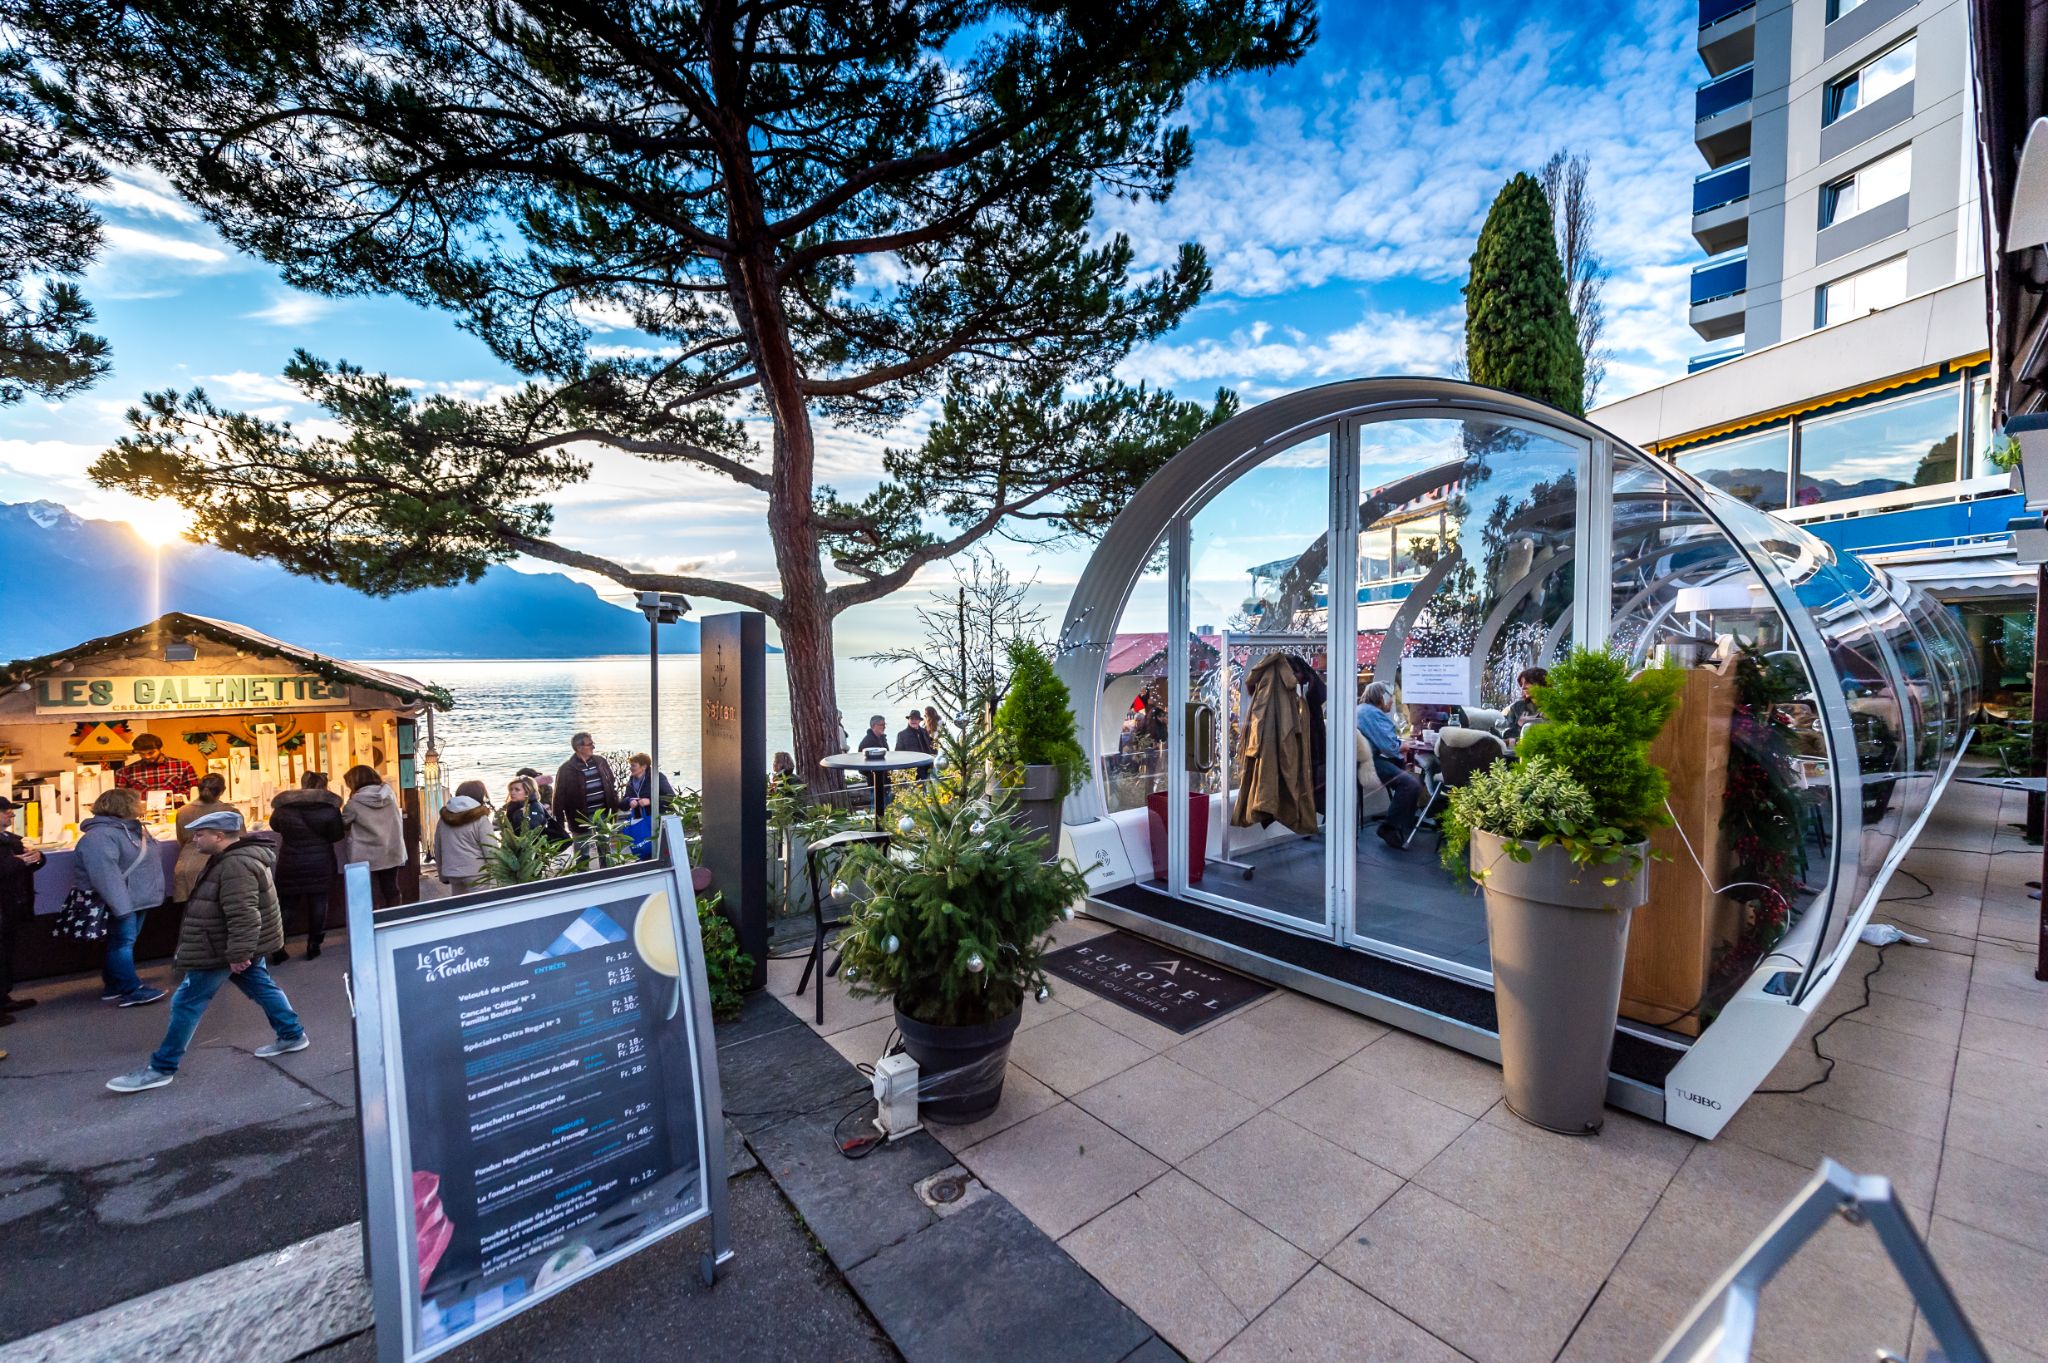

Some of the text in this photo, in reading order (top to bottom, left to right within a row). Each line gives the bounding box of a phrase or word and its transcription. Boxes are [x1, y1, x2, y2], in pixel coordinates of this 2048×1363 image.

[39, 680, 113, 707] LES
[177, 702, 215, 710] BIJOUX
[416, 946, 466, 970] Le Tube
[605, 952, 632, 964] Fr. 12.-
[426, 956, 490, 982] à Fondues
[608, 966, 634, 978] Fr. 12.-
[609, 974, 636, 986] Fr. 22.-
[1076, 947, 1220, 1010] EUROTEL
[1080, 959, 1186, 1006] MONTREUX
[458, 979, 529, 1002] Velouté de potiron
[1064, 964, 1168, 1014] TAKES YOU HIGHER
[612, 995, 638, 1007] Fr. 18.-
[624, 1002, 640, 1011] 30.-
[460, 1006, 492, 1020] Cancale
[461, 1014, 490, 1028] Famille
[464, 1036, 501, 1052] Spéciales
[502, 1029, 524, 1041] Ostra
[524, 1022, 545, 1033] Regal
[617, 1038, 644, 1050] Fr. 18.-
[618, 1045, 644, 1058] Fr. 22.-
[620, 1064, 647, 1078] Fr. 28.-
[478, 1085, 504, 1098] saumon
[504, 1078, 520, 1090] fumé
[521, 1075, 530, 1083] du
[530, 1068, 552, 1080] fumoir
[471, 1112, 515, 1132] Planchette
[516, 1094, 566, 1117] montagnarde
[624, 1102, 652, 1117] Fr. 25.-
[626, 1126, 654, 1140] Fr. 46.-
[474, 1162, 502, 1177] Fondue
[561, 1128, 588, 1142] fromage
[630, 1169, 656, 1185] Fr. 12.-
[488, 1184, 516, 1200] fondue
[480, 1228, 508, 1246] Double
[534, 1212, 544, 1220] de
[546, 1208, 553, 1216] la
[586, 1179, 618, 1198] meringue
[481, 1236, 510, 1254] maison
[575, 1196, 598, 1210] kirsch
[528, 1244, 542, 1256] des
[544, 1234, 565, 1248] fruits
[492, 1246, 520, 1263] fondue
